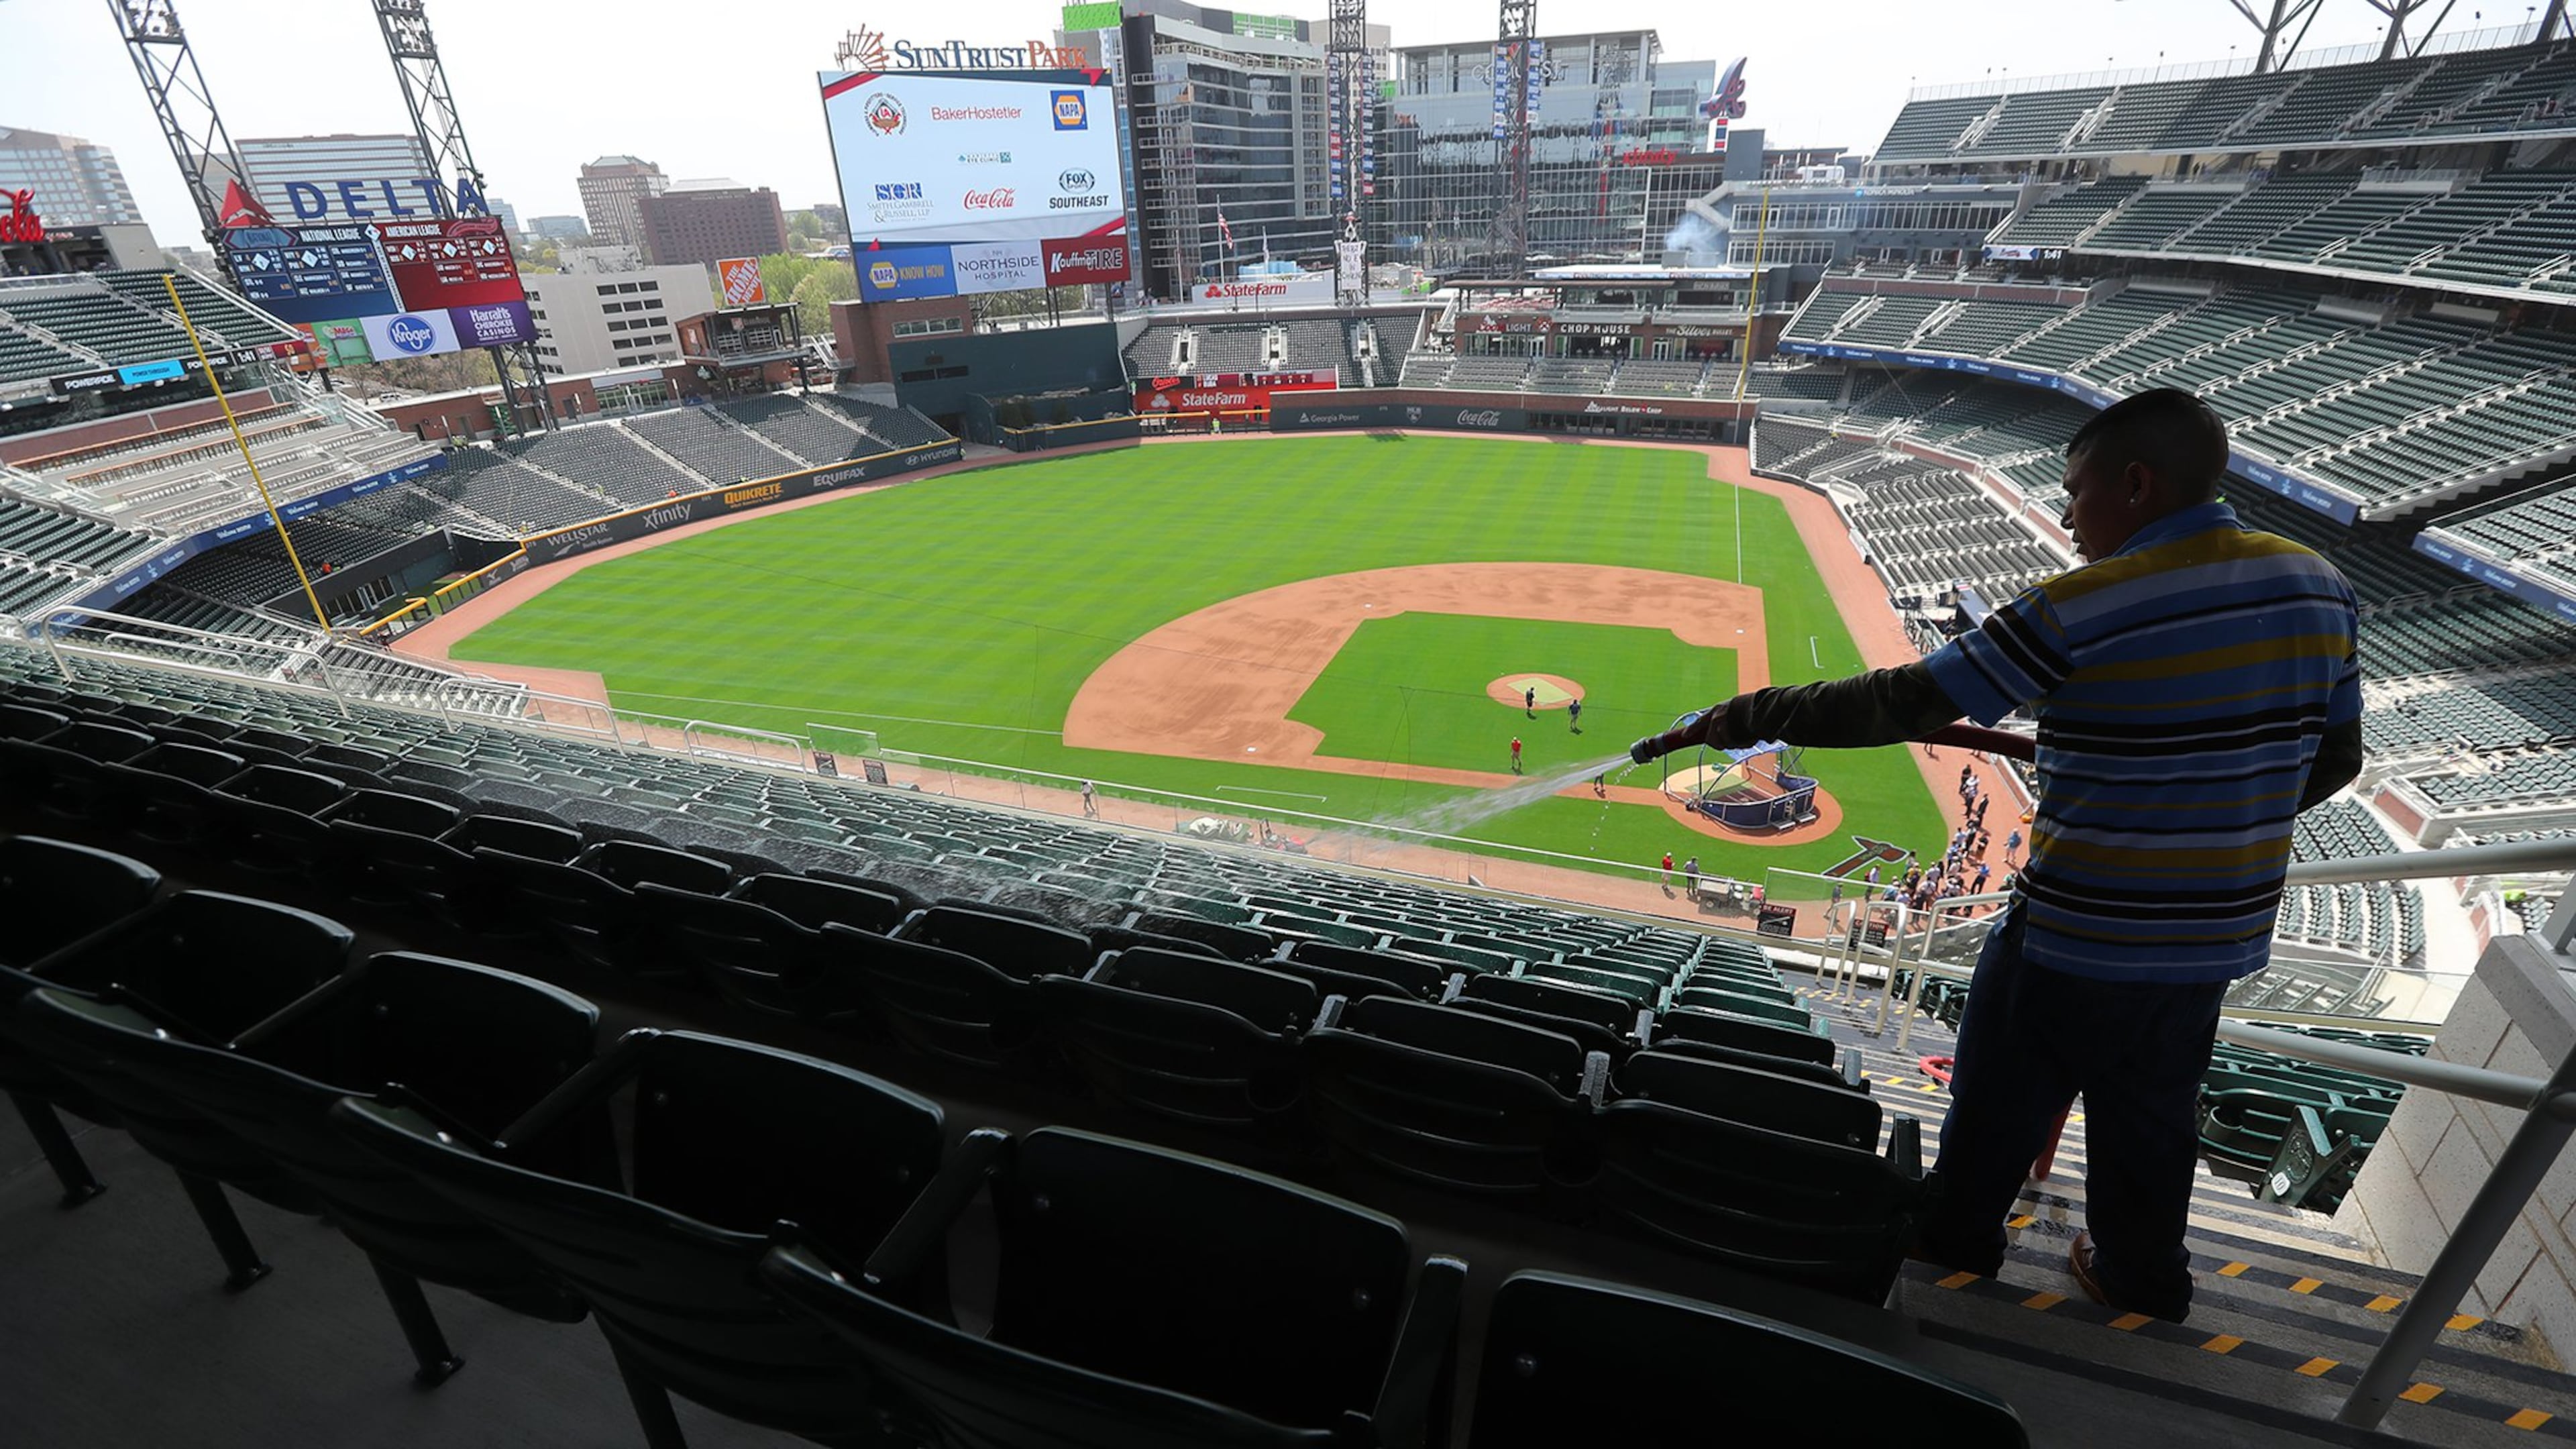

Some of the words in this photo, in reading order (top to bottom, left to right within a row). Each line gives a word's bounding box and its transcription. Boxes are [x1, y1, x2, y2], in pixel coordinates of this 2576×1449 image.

[931, 105, 1022, 121] BakerHostetler
[1059, 103, 1081, 118] NAPA
[1066, 172, 1088, 184] FOX
[284, 178, 490, 219] DELTA
[1049, 195, 1110, 209] SOUTHEAST
[299, 228, 335, 243] NATIONAL
[335, 227, 362, 241] LEAGUE
[384, 225, 418, 237] AMERICAN
[418, 223, 443, 236] LEAGUE
[1085, 248, 1123, 271] TIRE
[2043, 250, 2063, 260] 1:41
[958, 256, 1040, 271] NORTHSIDE
[726, 264, 741, 280] THE
[873, 269, 896, 281] NAPA
[900, 266, 924, 280] KNOW
[926, 264, 945, 278] HOW
[975, 271, 1026, 280] HOSPITAL
[725, 260, 757, 305] HOME
[741, 275, 761, 303] DEPOT
[474, 319, 515, 330] CHEROKEE
[477, 327, 516, 337] CASINOS
[1505, 323, 1532, 332] LIGHT
[1560, 323, 1591, 333] CHOP
[392, 321, 433, 350] Kroger
[236, 351, 256, 364] 1:41
[64, 373, 115, 390] POWERADE
[1311, 413, 1338, 424] Georgia
[1338, 413, 1360, 423] Power
[920, 447, 958, 462] HYUNDAI
[813, 466, 865, 487] EQUIFAX
[724, 482, 784, 504] QUIKRETE
[643, 503, 692, 530] xfinity
[546, 523, 608, 547] WELLSTAR
[1772, 906, 1794, 915] ALERT
